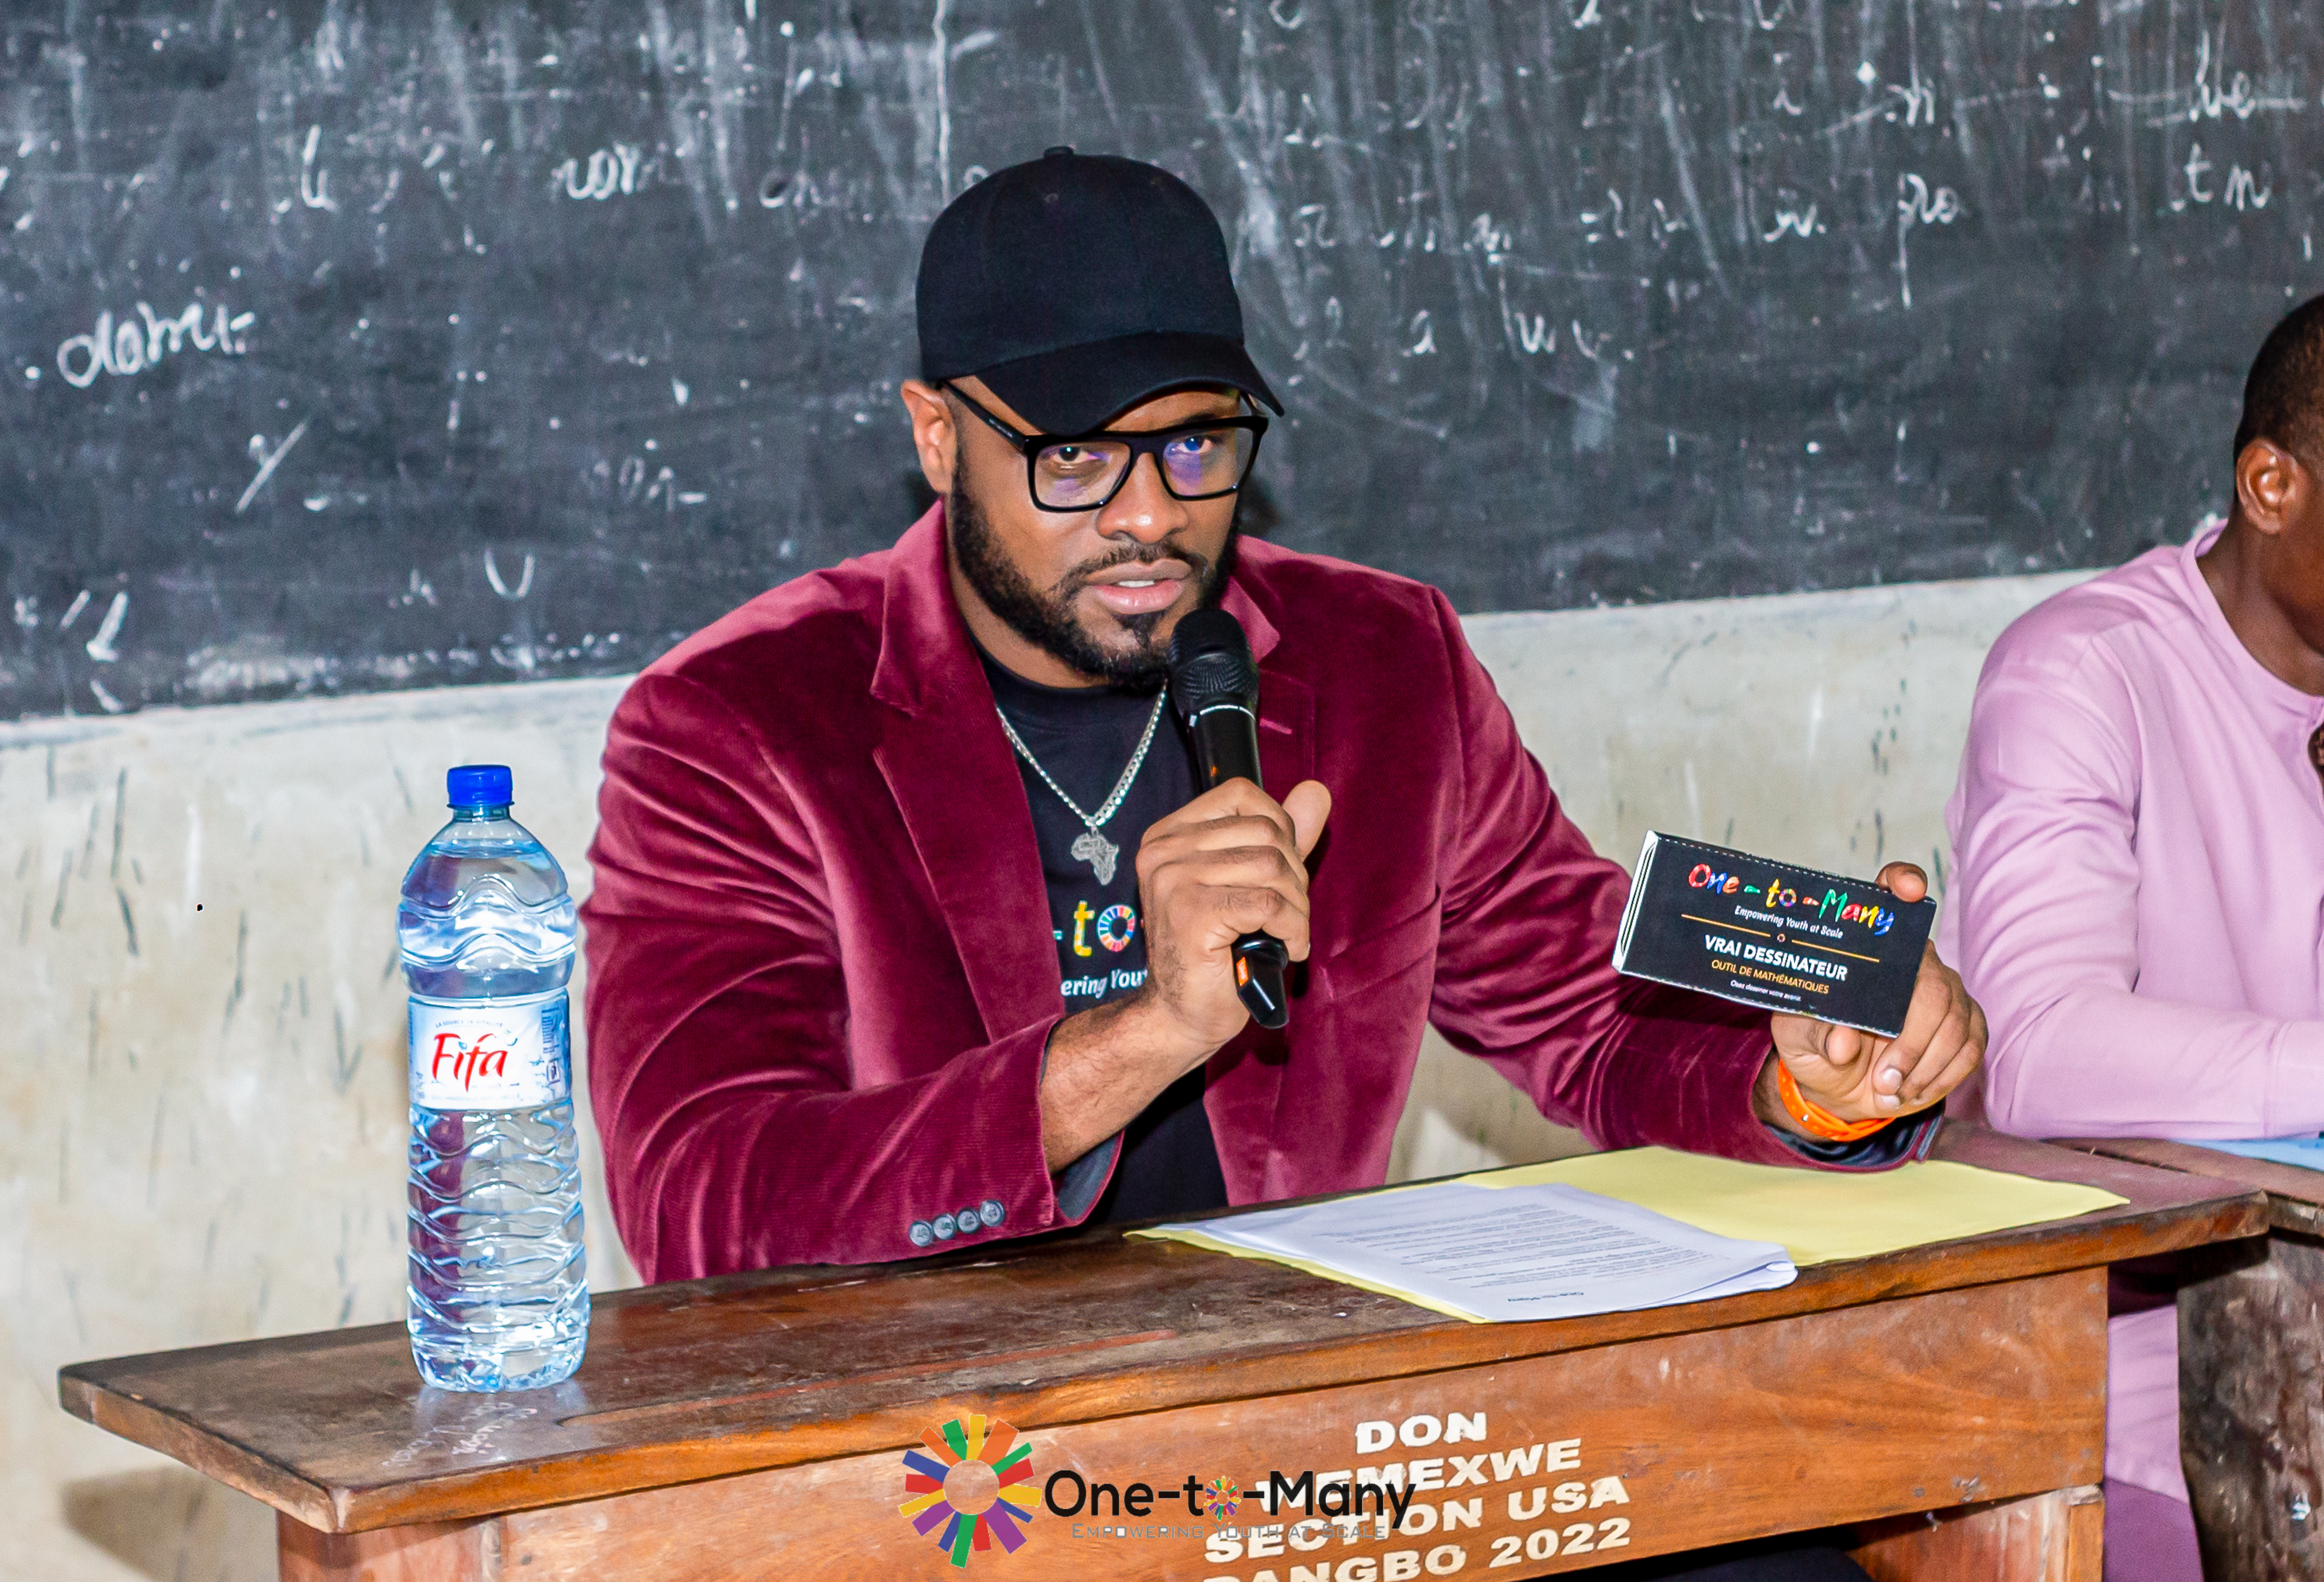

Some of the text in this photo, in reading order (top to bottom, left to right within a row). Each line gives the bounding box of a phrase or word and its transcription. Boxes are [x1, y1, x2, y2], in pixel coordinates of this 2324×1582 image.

[1689, 864, 1895, 935] One-to-Many
[1735, 905, 1843, 940] Empowering Youth at Scale
[1704, 935, 1848, 981] VRAI DESSINATEUR
[1711, 959, 1829, 995] OUTIL DE MATHÉMATIQUES
[1060, 975, 1107, 999] ering
[432, 1033, 508, 1092] Fifa
[1356, 1411, 1487, 1454] DON
[1204, 1475, 1630, 1564] SECTION USA
[1489, 1517, 1631, 1569] 2022
